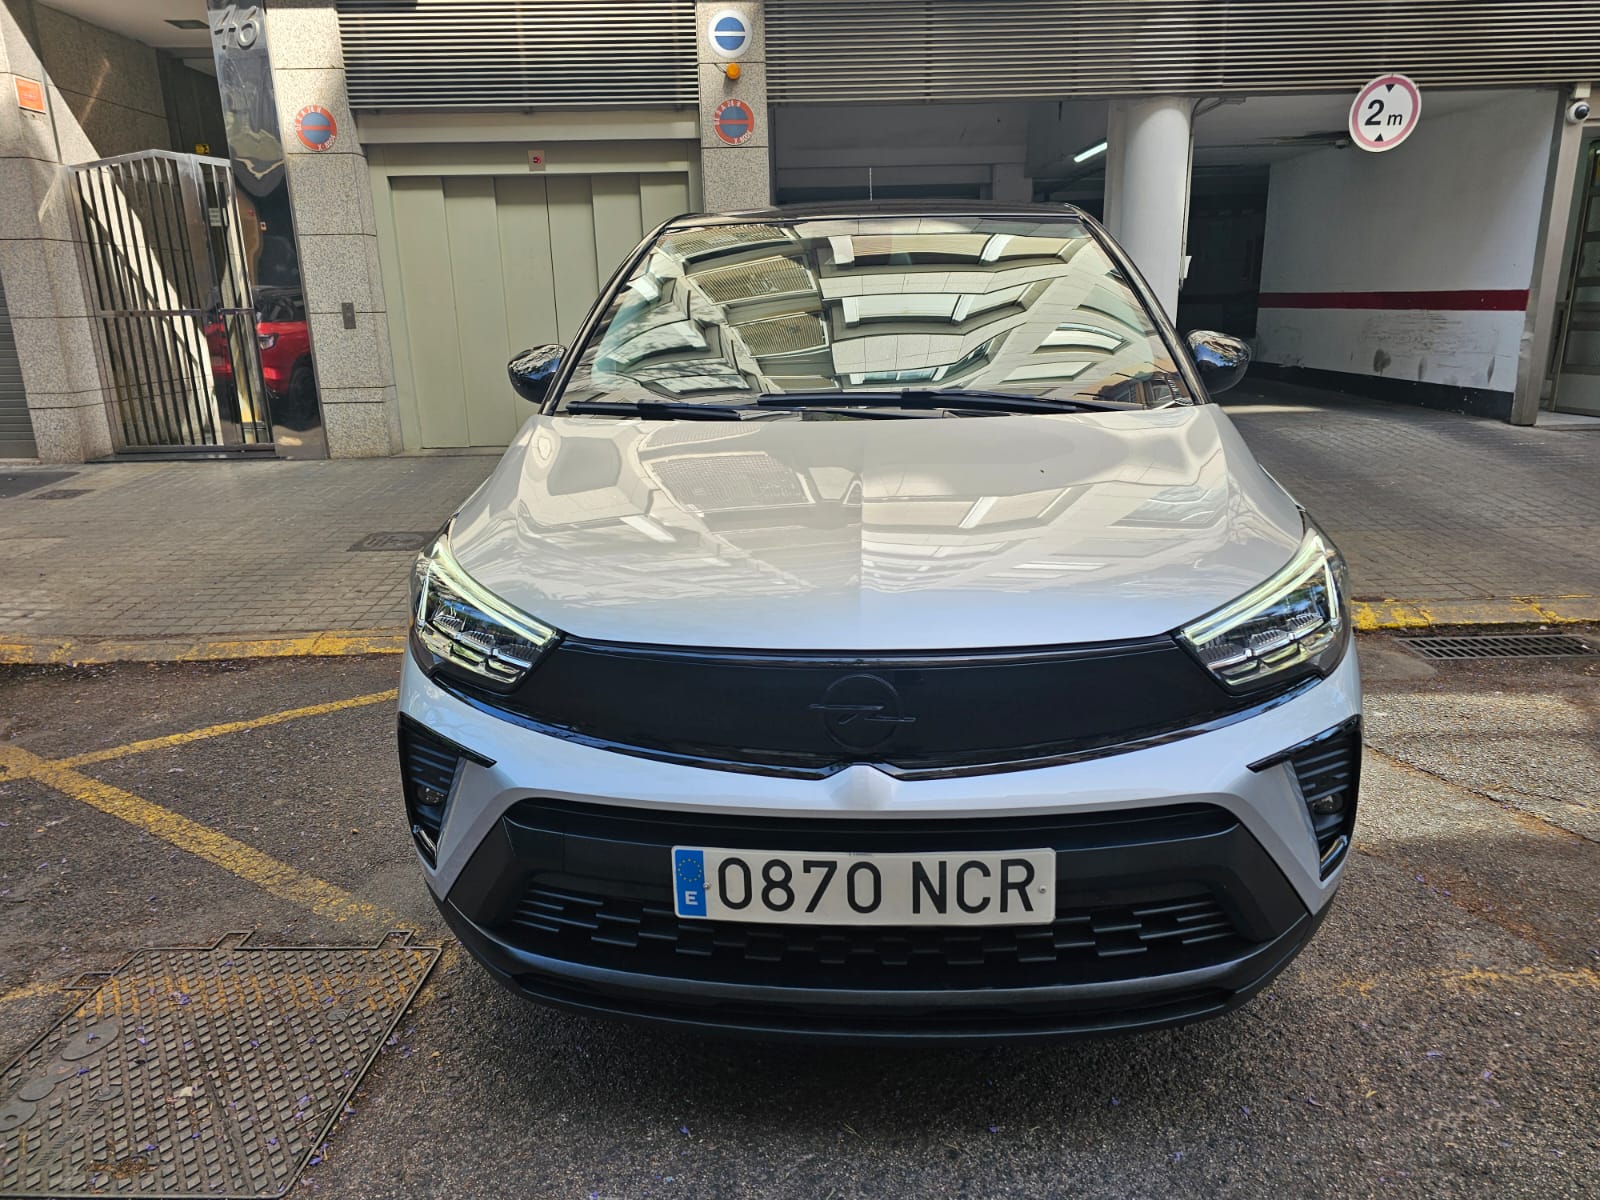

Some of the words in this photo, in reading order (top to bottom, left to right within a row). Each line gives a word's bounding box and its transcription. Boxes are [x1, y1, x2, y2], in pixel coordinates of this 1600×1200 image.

[213, 3, 260, 50] 46
[1365, 99, 1385, 126] 2
[1387, 114, 1403, 126] m
[684, 890, 699, 906] E
[717, 857, 882, 914] 0870
[911, 858, 1035, 914] NCR
